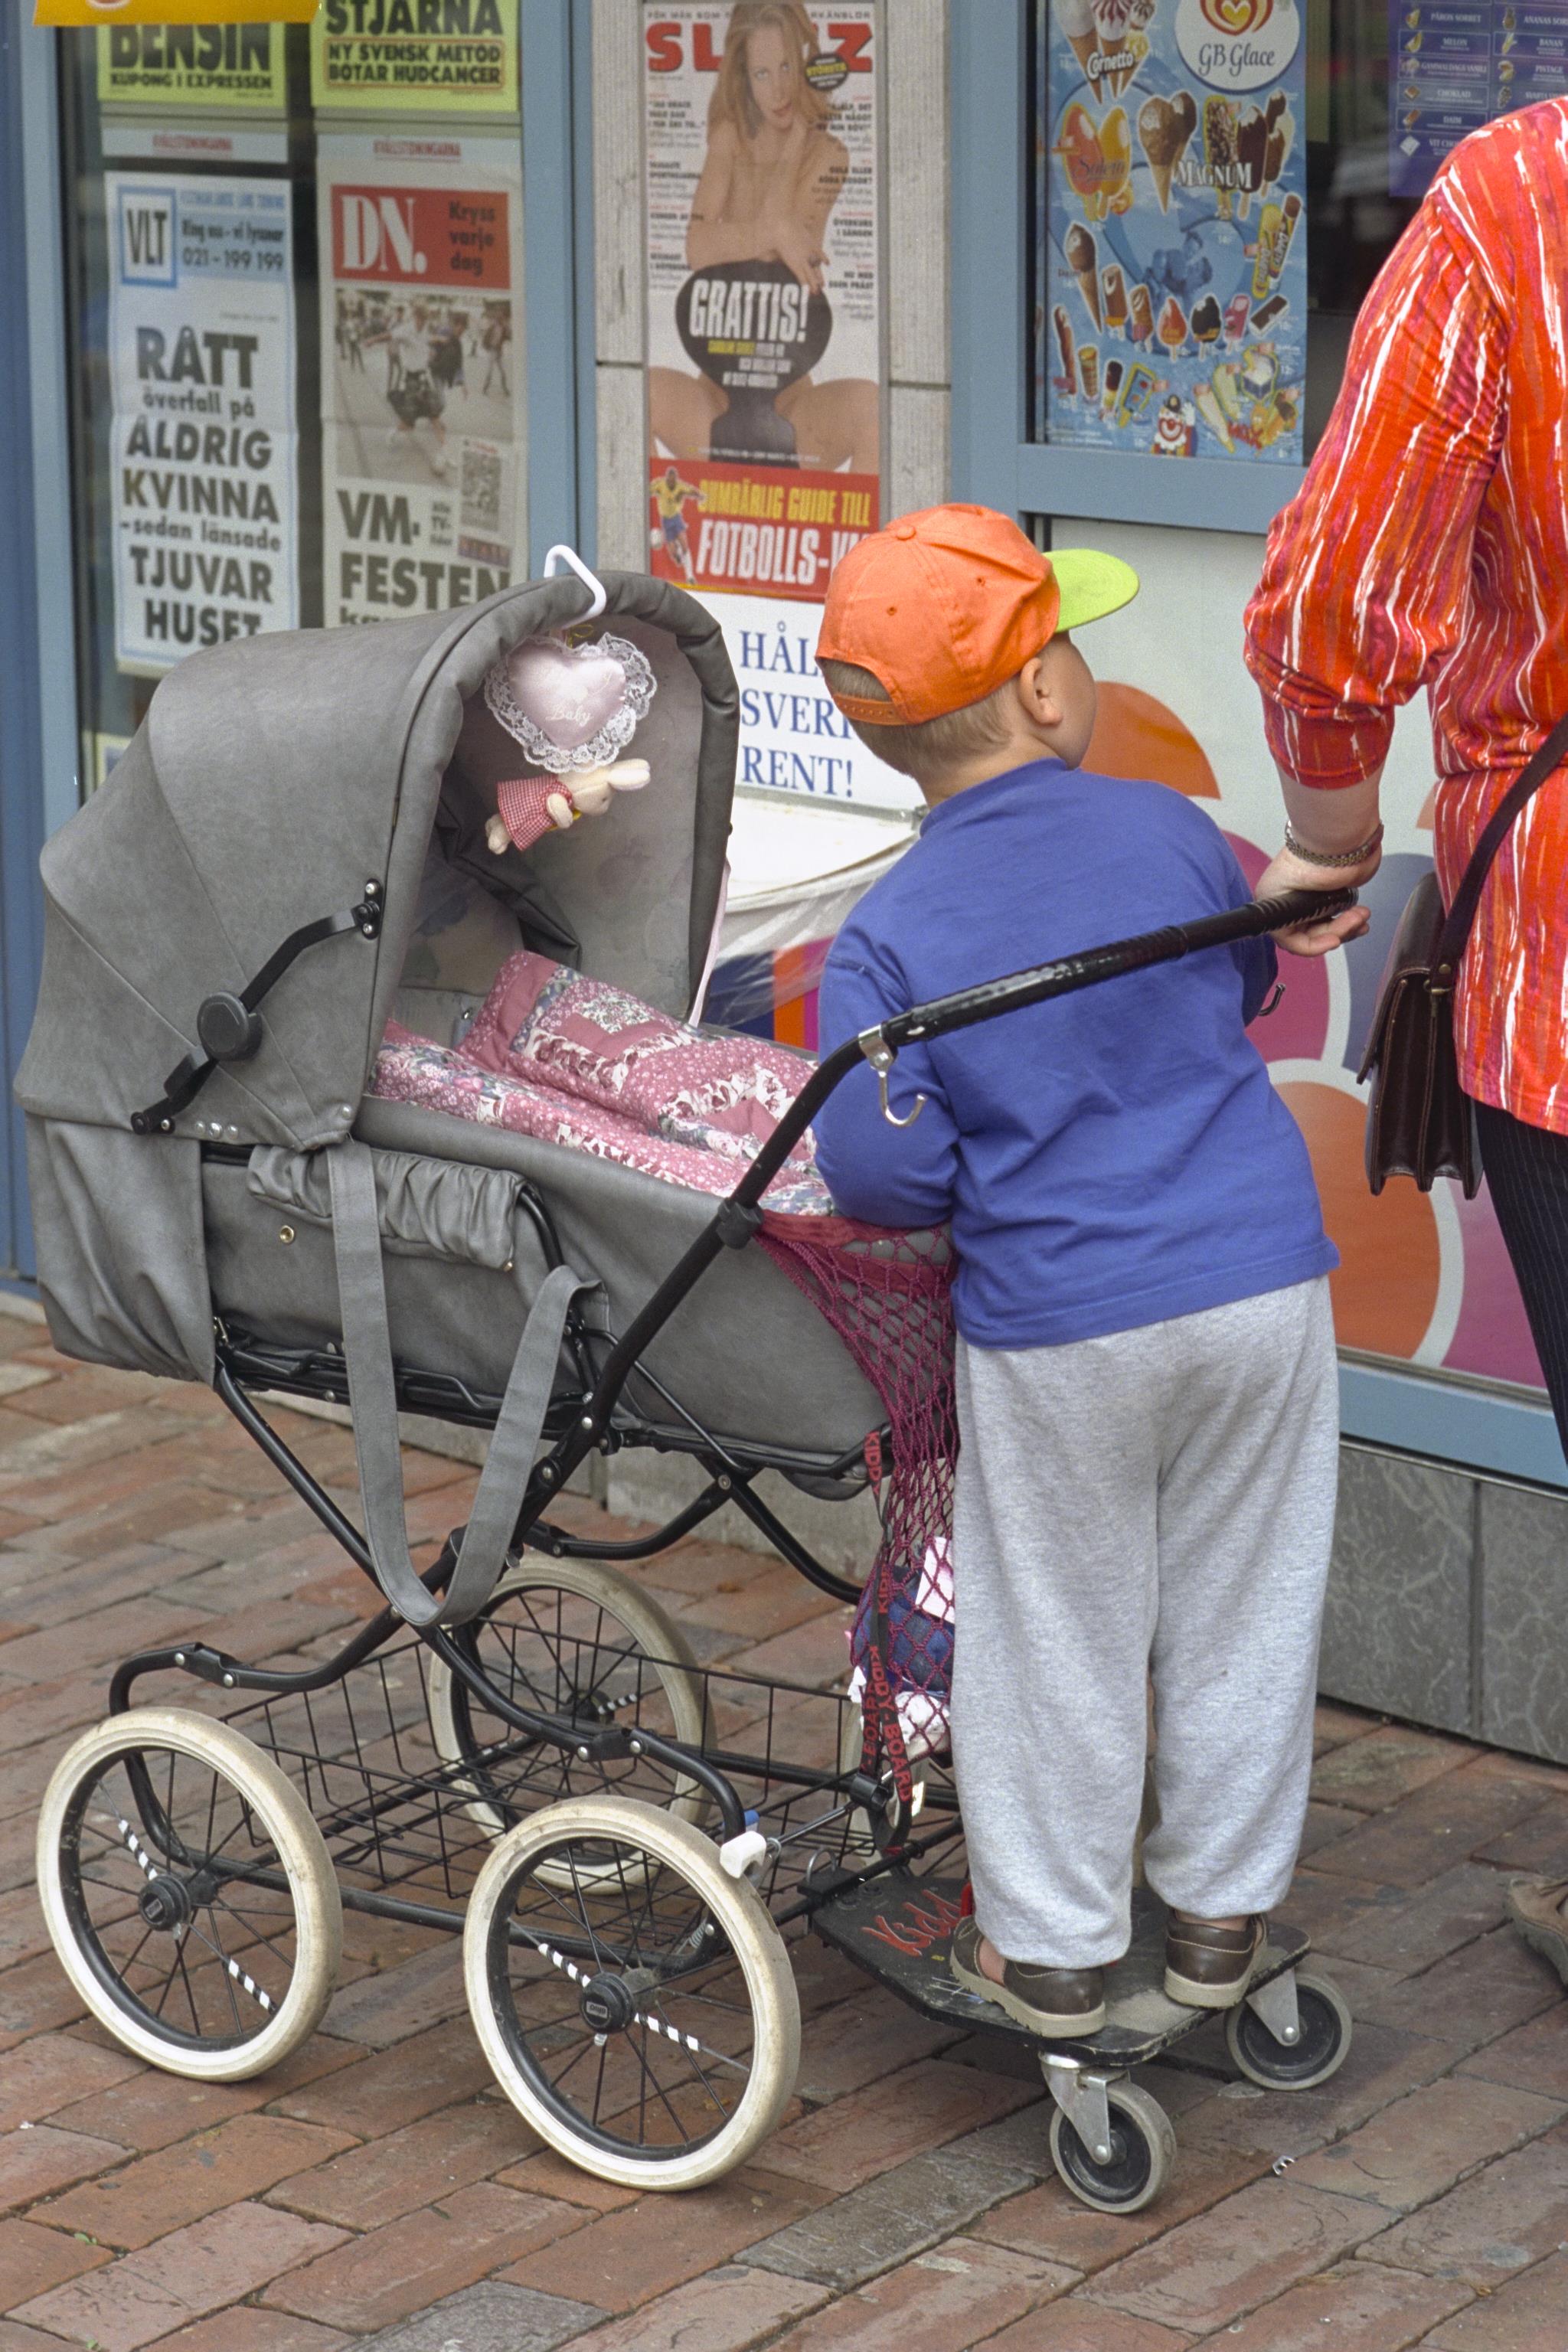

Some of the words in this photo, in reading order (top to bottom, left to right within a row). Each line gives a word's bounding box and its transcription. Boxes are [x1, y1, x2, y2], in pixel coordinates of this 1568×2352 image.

[111, 24, 270, 70] BENSIN
[328, 43, 352, 60] NY
[358, 43, 430, 61] SVENSK
[436, 44, 501, 62] METOD
[646, 21, 873, 73] SLZ
[1198, 43, 1227, 77] GB
[1229, 42, 1274, 77] Glace
[1443, 38, 1468, 47] MELON
[1539, 38, 1563, 47] BANAN
[111, 73, 172, 87] KUPONG
[176, 74, 182, 87] I
[188, 74, 272, 90] EXPRESSEN
[328, 64, 388, 81] BOTAR
[394, 65, 501, 83] HUDCANCER
[1087, 51, 1135, 80] Cornetto
[1177, 160, 1253, 189] MAGNUM
[181, 219, 205, 243] Ring
[449, 200, 496, 224] Kryss
[126, 208, 168, 265] VLT
[341, 194, 428, 275] DN.
[449, 227, 495, 251] varje
[182, 247, 209, 266] 021
[224, 249, 251, 269] 199
[257, 251, 284, 271] 199
[450, 251, 483, 278] dag
[689, 278, 811, 343] GRATTIS!
[136, 325, 258, 389] RÅTT
[142, 387, 221, 414] överfall
[230, 396, 255, 422] på
[122, 467, 280, 524] KVINNA
[787, 486, 838, 524] GUIDE
[841, 491, 871, 527] TILL
[133, 516, 192, 540] sedan
[129, 545, 273, 604] TJUVAR
[341, 551, 512, 610] FESTEN
[145, 598, 261, 647] HUSET
[739, 619, 824, 678] HÅL
[742, 744, 854, 798] RENT!
[869, 1645, 896, 1712] KIDDY
[884, 1723, 913, 1802] BOARD
[860, 1889, 962, 1958] Kidd
